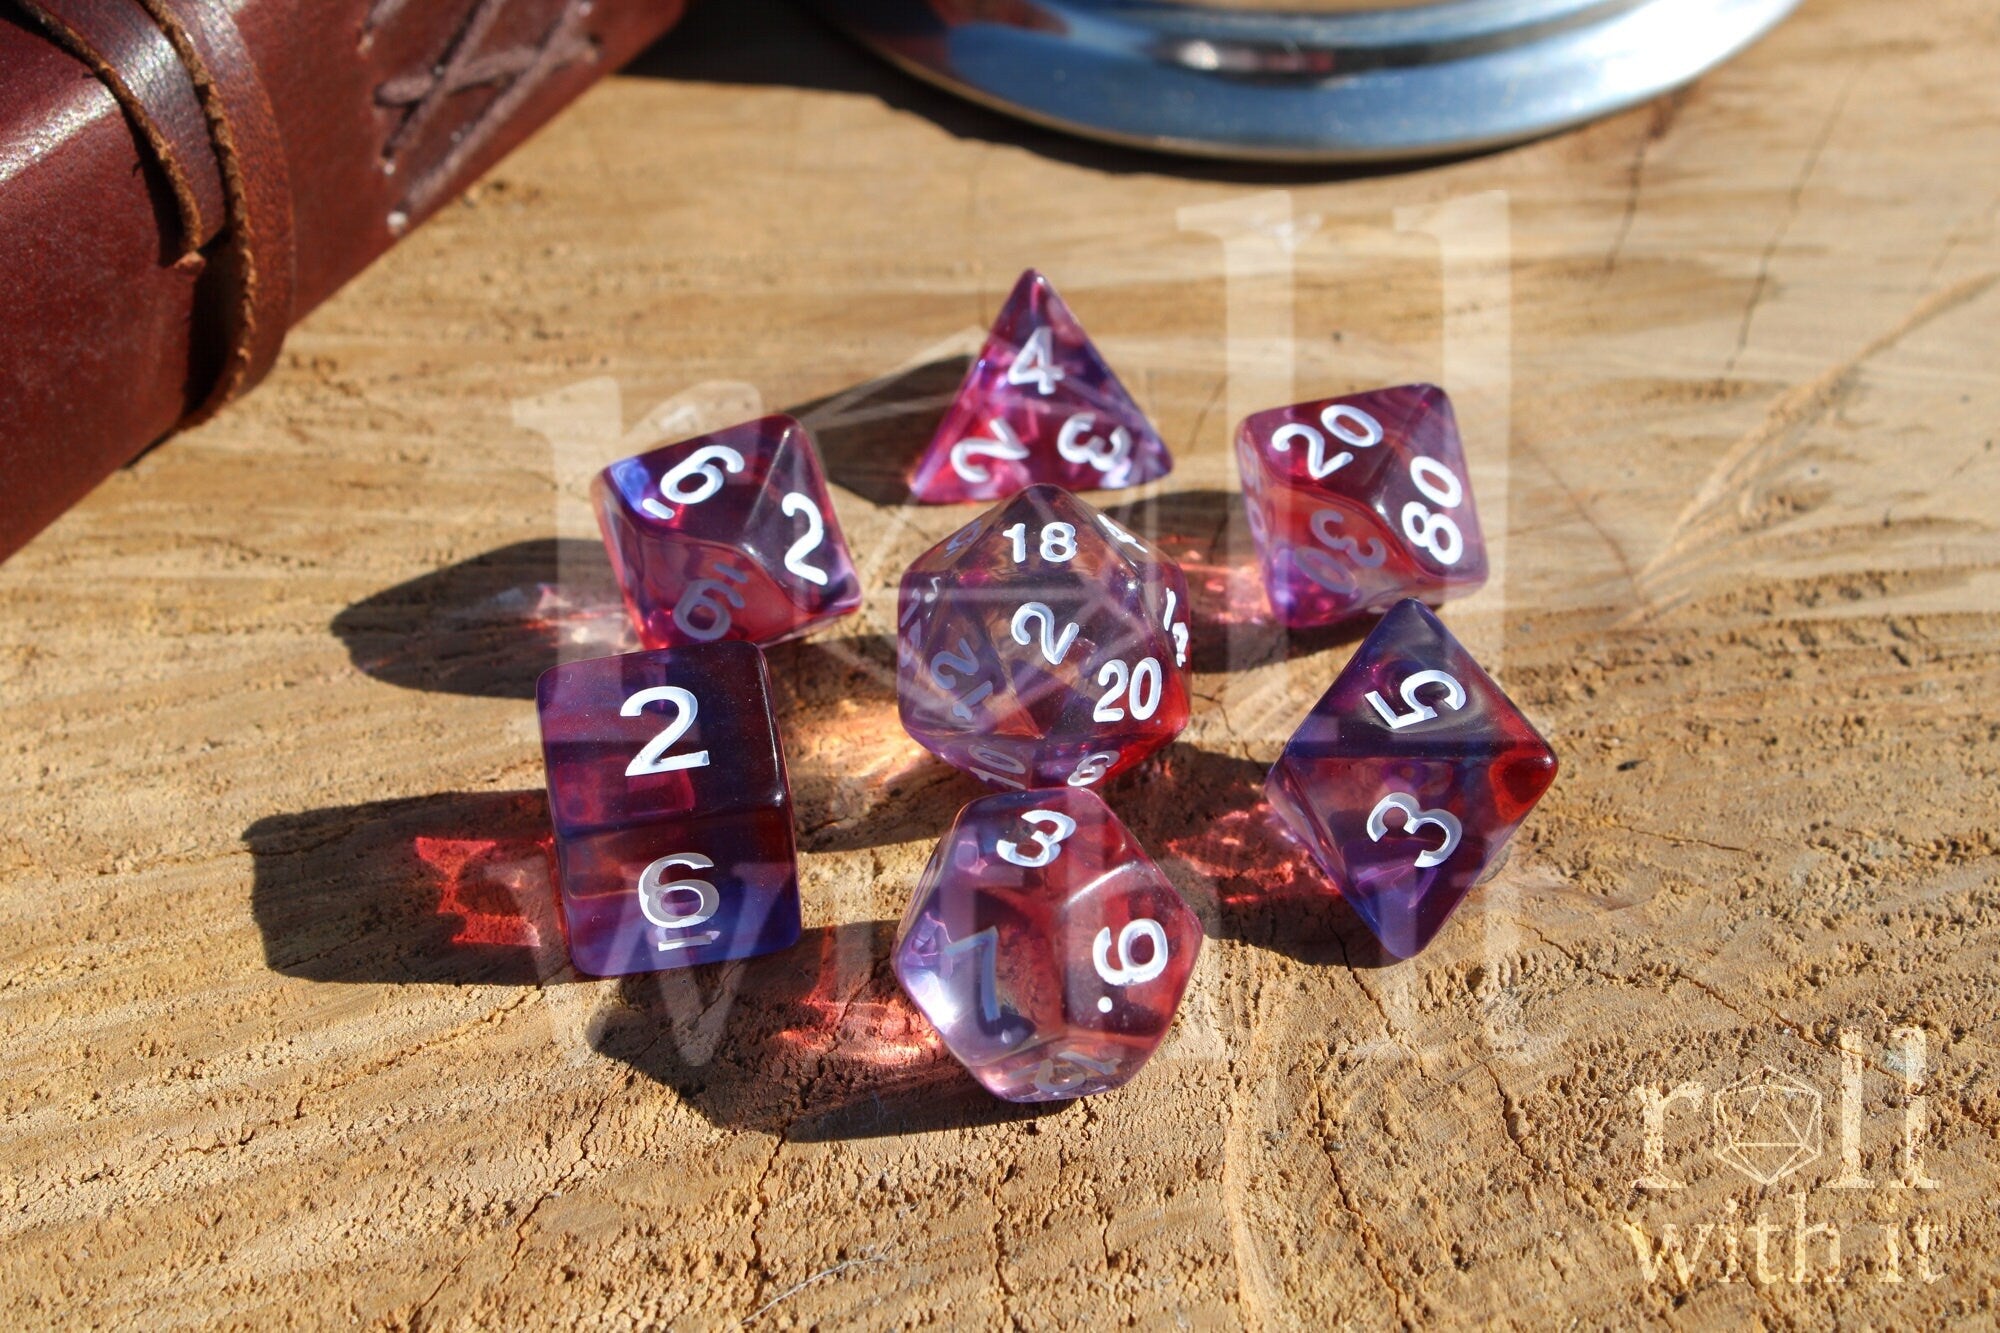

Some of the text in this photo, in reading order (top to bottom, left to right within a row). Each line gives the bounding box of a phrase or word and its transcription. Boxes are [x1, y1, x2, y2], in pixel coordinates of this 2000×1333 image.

[1008, 327, 1065, 394] 4
[951, 418, 1030, 483] 2
[1057, 412, 1132, 472] 3
[1271, 404, 1384, 479] 20
[782, 492, 828, 586] 2
[1002, 522, 1078, 563] 18
[1401, 455, 1463, 565] 80
[1011, 602, 1080, 665] 2
[1093, 656, 1162, 723] 20
[1364, 669, 1467, 729] 5
[620, 685, 711, 777] 2
[995, 809, 1077, 868] 3
[1366, 791, 1463, 868] 3
